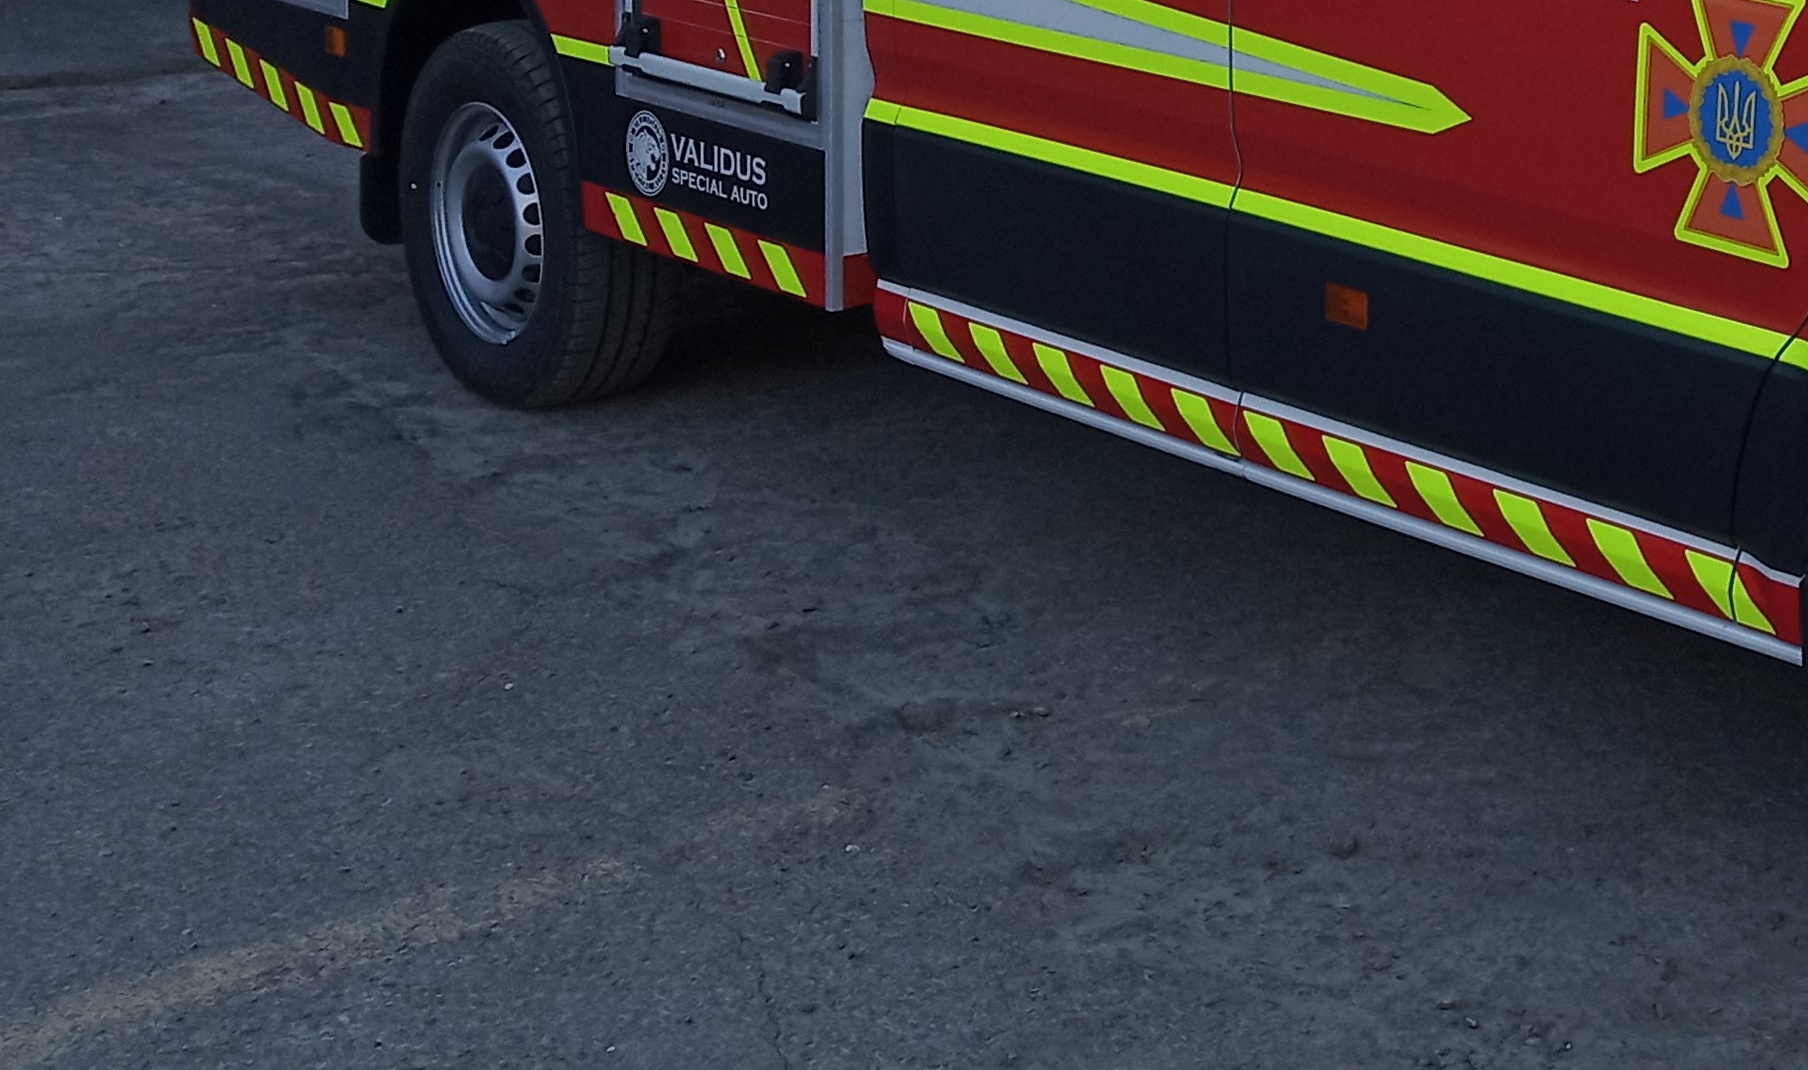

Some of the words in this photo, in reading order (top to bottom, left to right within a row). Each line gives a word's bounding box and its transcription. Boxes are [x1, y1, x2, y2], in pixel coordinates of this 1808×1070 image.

[670, 133, 766, 185] VALIDUS
[671, 167, 728, 199] SPECIAL
[730, 185, 768, 210] AUTO
